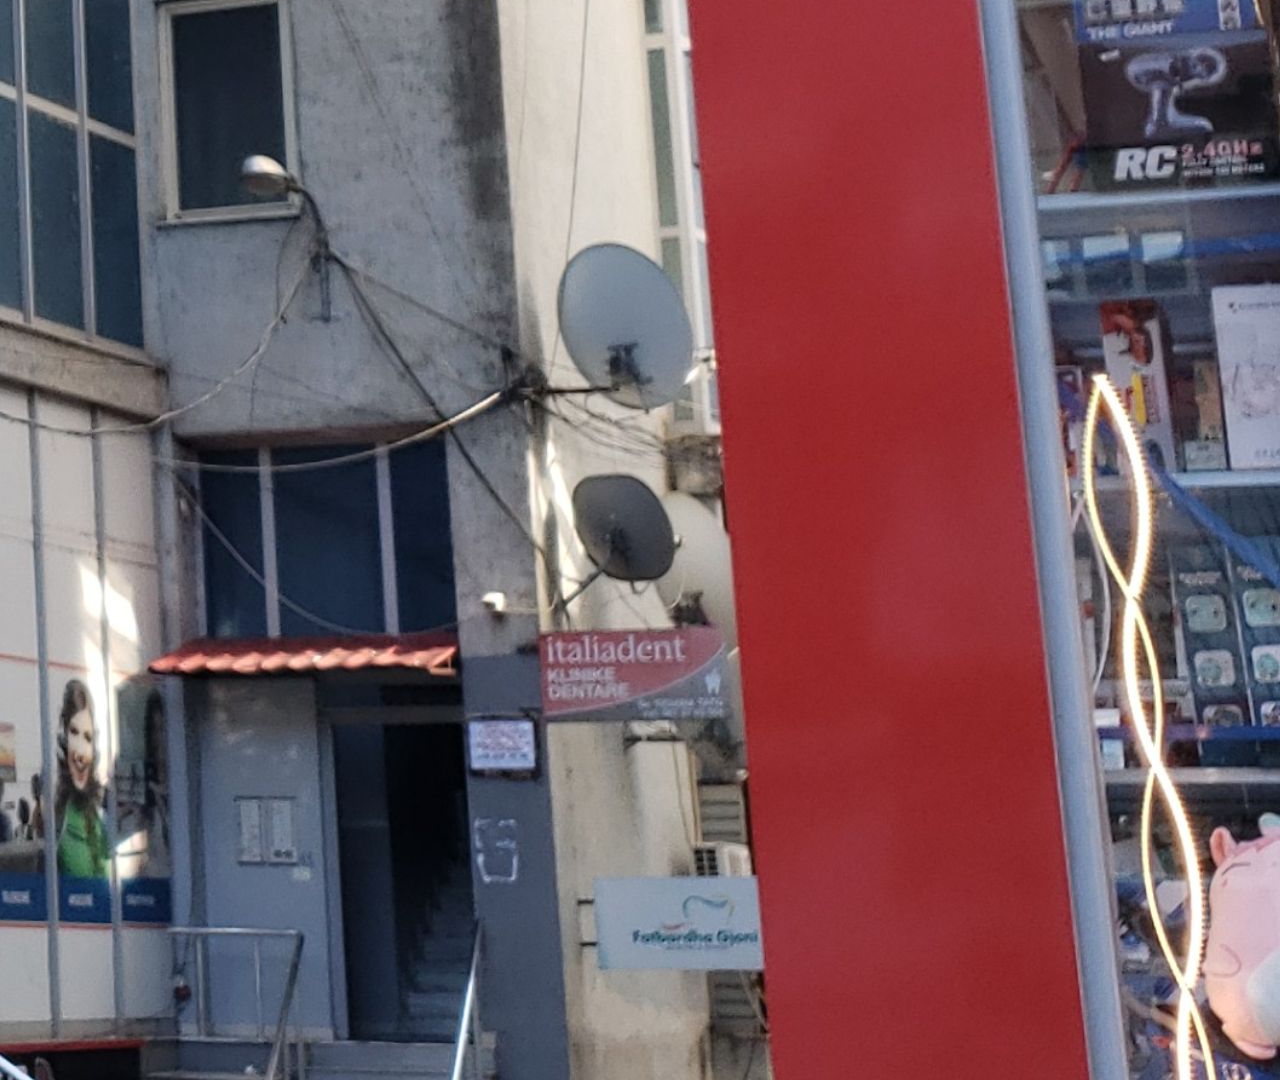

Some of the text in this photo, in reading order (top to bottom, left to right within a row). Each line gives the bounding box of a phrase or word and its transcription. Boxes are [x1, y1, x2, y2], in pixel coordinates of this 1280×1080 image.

[1114, 145, 1178, 181] RC
[547, 635, 687, 664] italiadent
[548, 683, 631, 700] DENTARE
